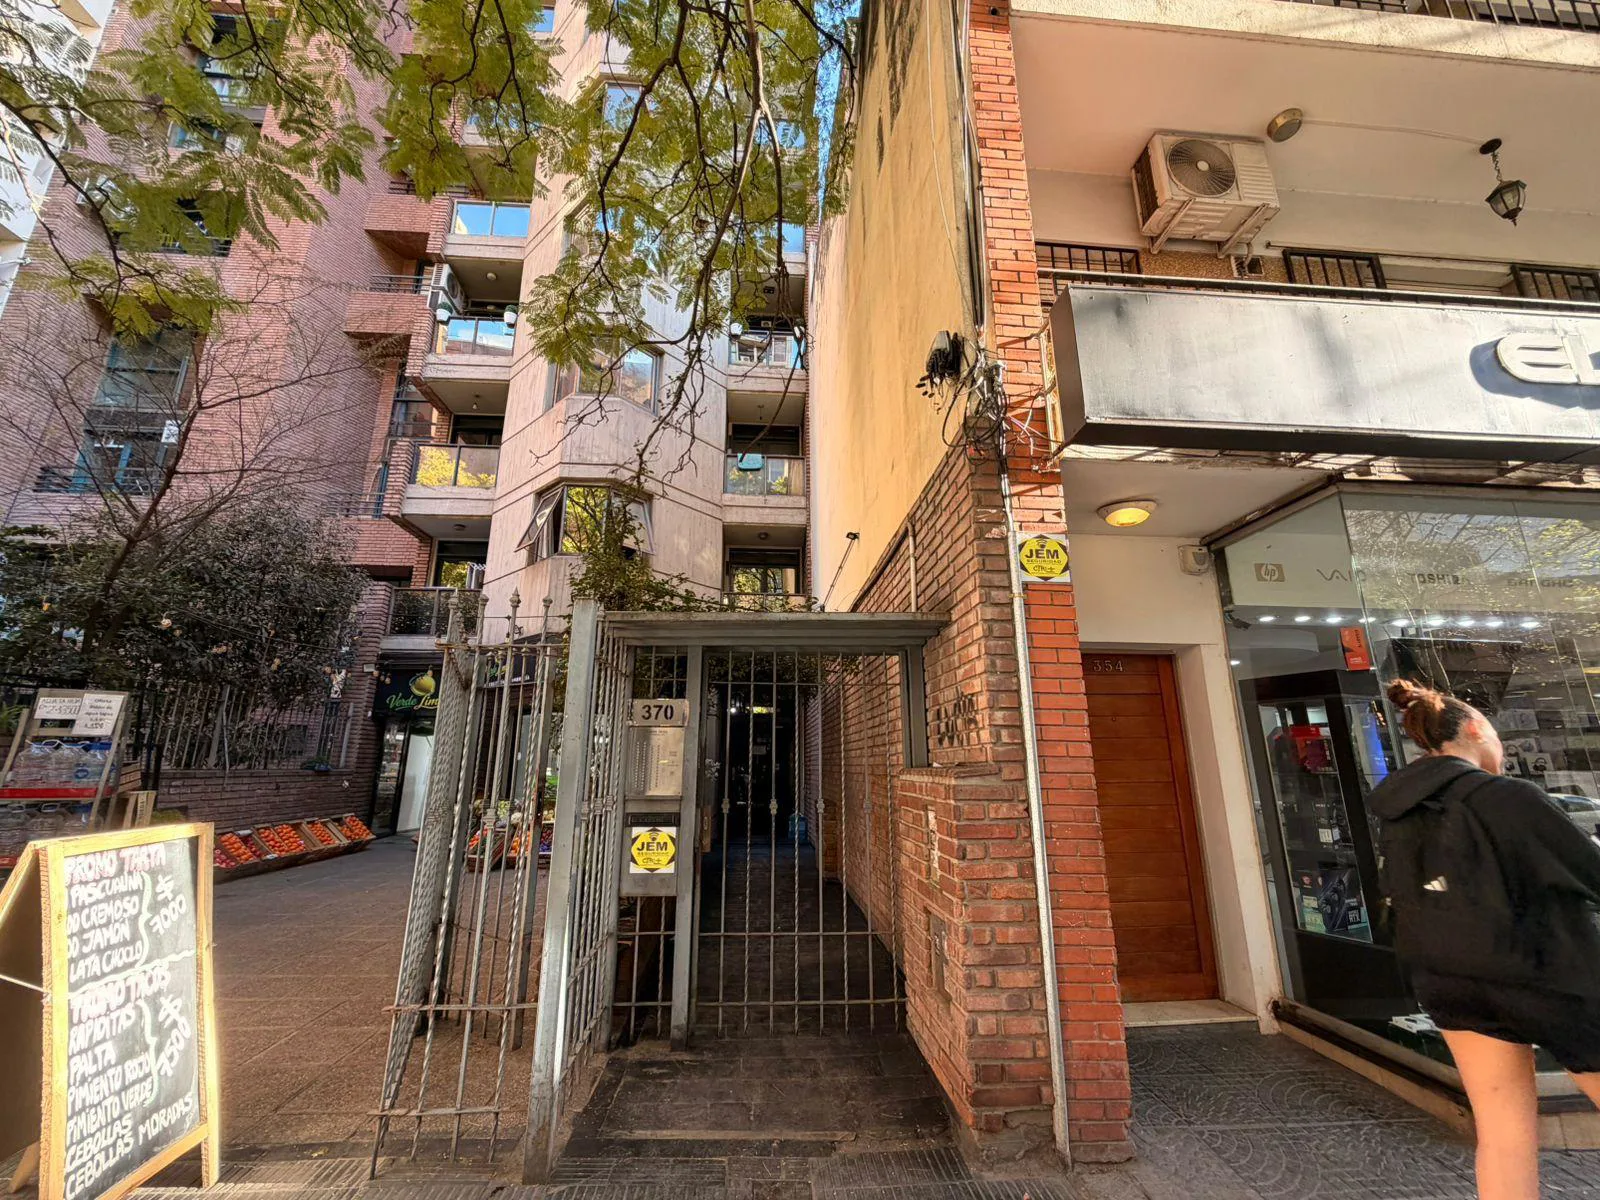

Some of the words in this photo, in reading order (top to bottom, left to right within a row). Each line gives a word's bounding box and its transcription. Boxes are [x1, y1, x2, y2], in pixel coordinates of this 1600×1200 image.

[1025, 548, 1060, 559] JEM
[1093, 660, 1123, 671] 354
[386, 692, 417, 710] Verde
[641, 704, 674, 720] 370
[64, 850, 118, 884] PROMO
[119, 843, 166, 872] TARTA
[637, 841, 668, 851] JEM
[70, 871, 143, 908] PASCUALINA
[81, 895, 139, 928] CREMOSO
[70, 951, 101, 983] LATA
[102, 940, 142, 973] CHOCLO
[70, 1040, 116, 1086] PALTA
[68, 1064, 122, 1116] PIMIENTO
[124, 1053, 151, 1085] ROJO
[66, 1095, 120, 1148] PIMIENTO
[121, 1076, 152, 1110] VERDE
[65, 1131, 134, 1200] CEBOLLAS
[138, 1091, 193, 1146] MORADAS
[66, 1113, 132, 1172] CEBOLLAS
